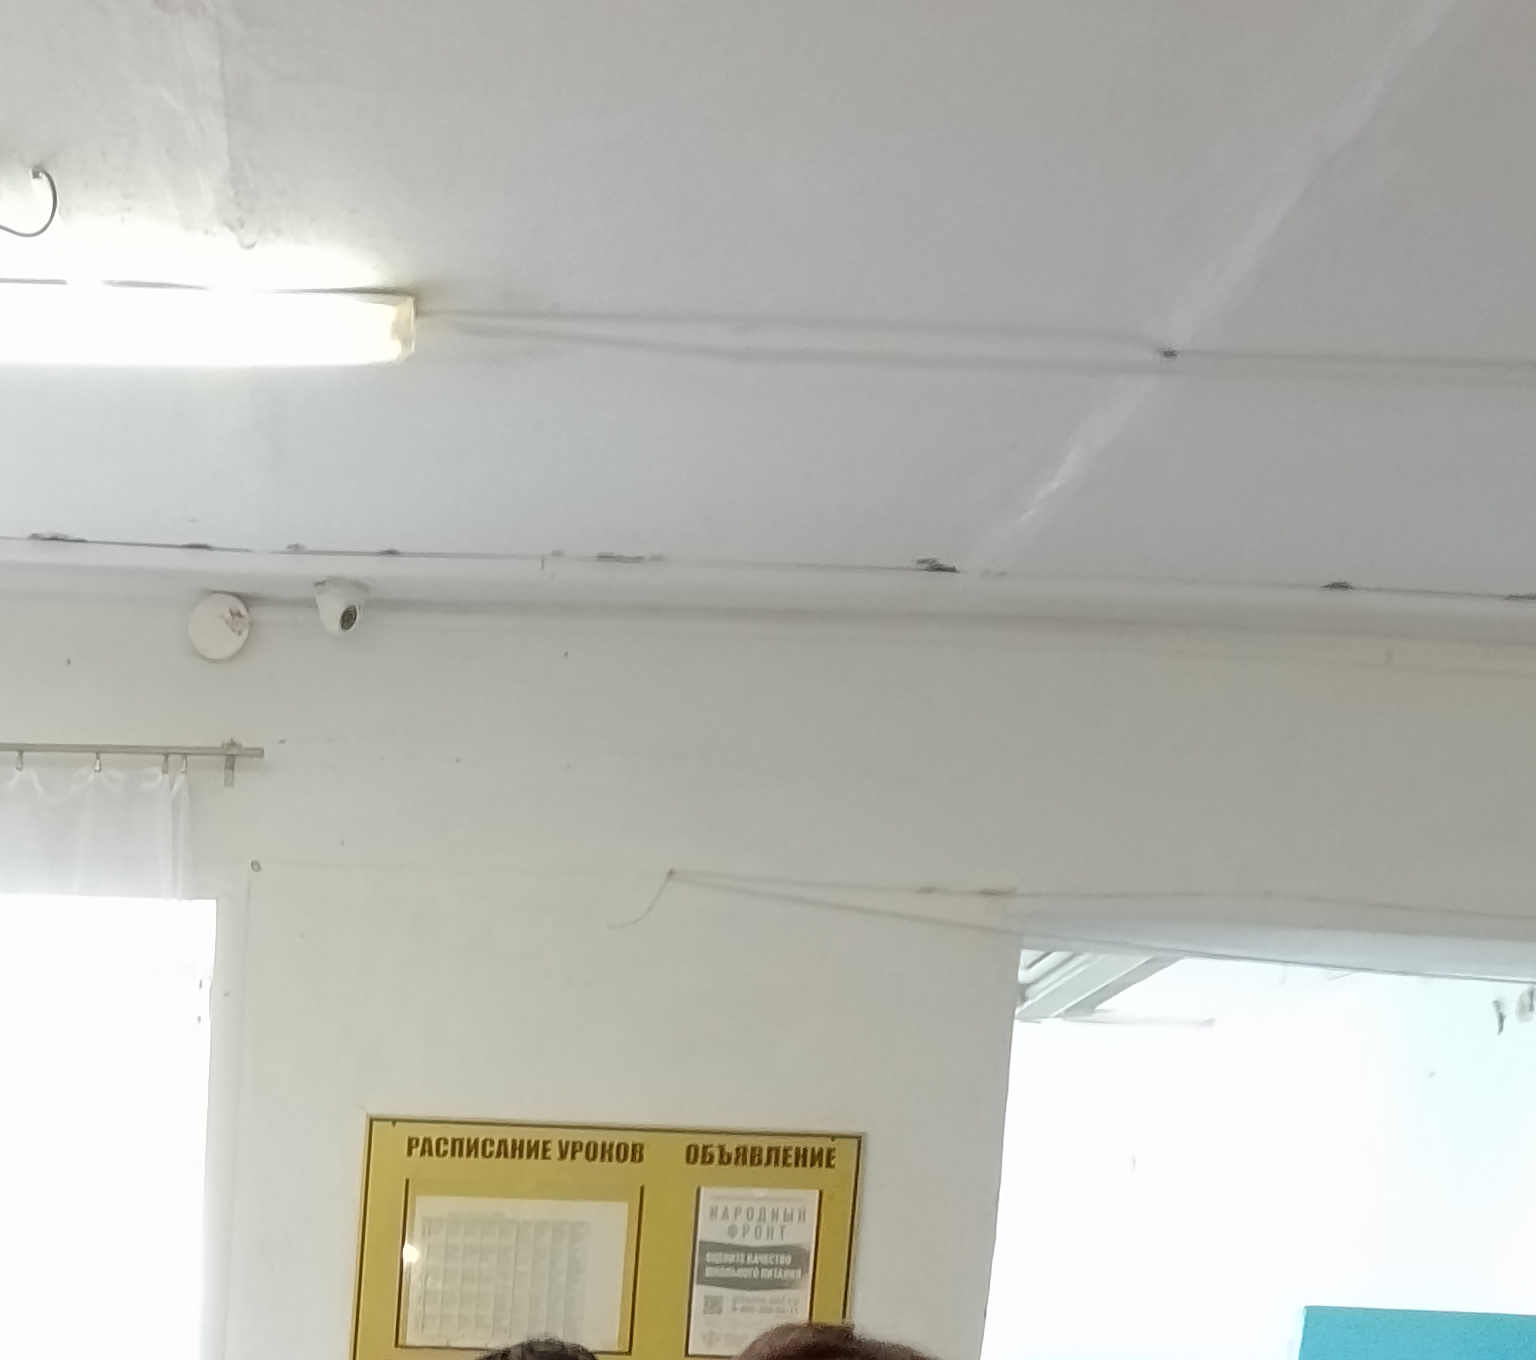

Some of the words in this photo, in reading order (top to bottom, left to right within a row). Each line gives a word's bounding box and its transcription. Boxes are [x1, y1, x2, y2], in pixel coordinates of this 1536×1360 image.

[406, 1135, 552, 1160] РАСПИСАНИЕ
[557, 1139, 646, 1164] УРОКОВ
[685, 1143, 837, 1169] ОБЪЯВЛЕНИЕ
[727, 1223, 787, 1241] ФРОНТ
